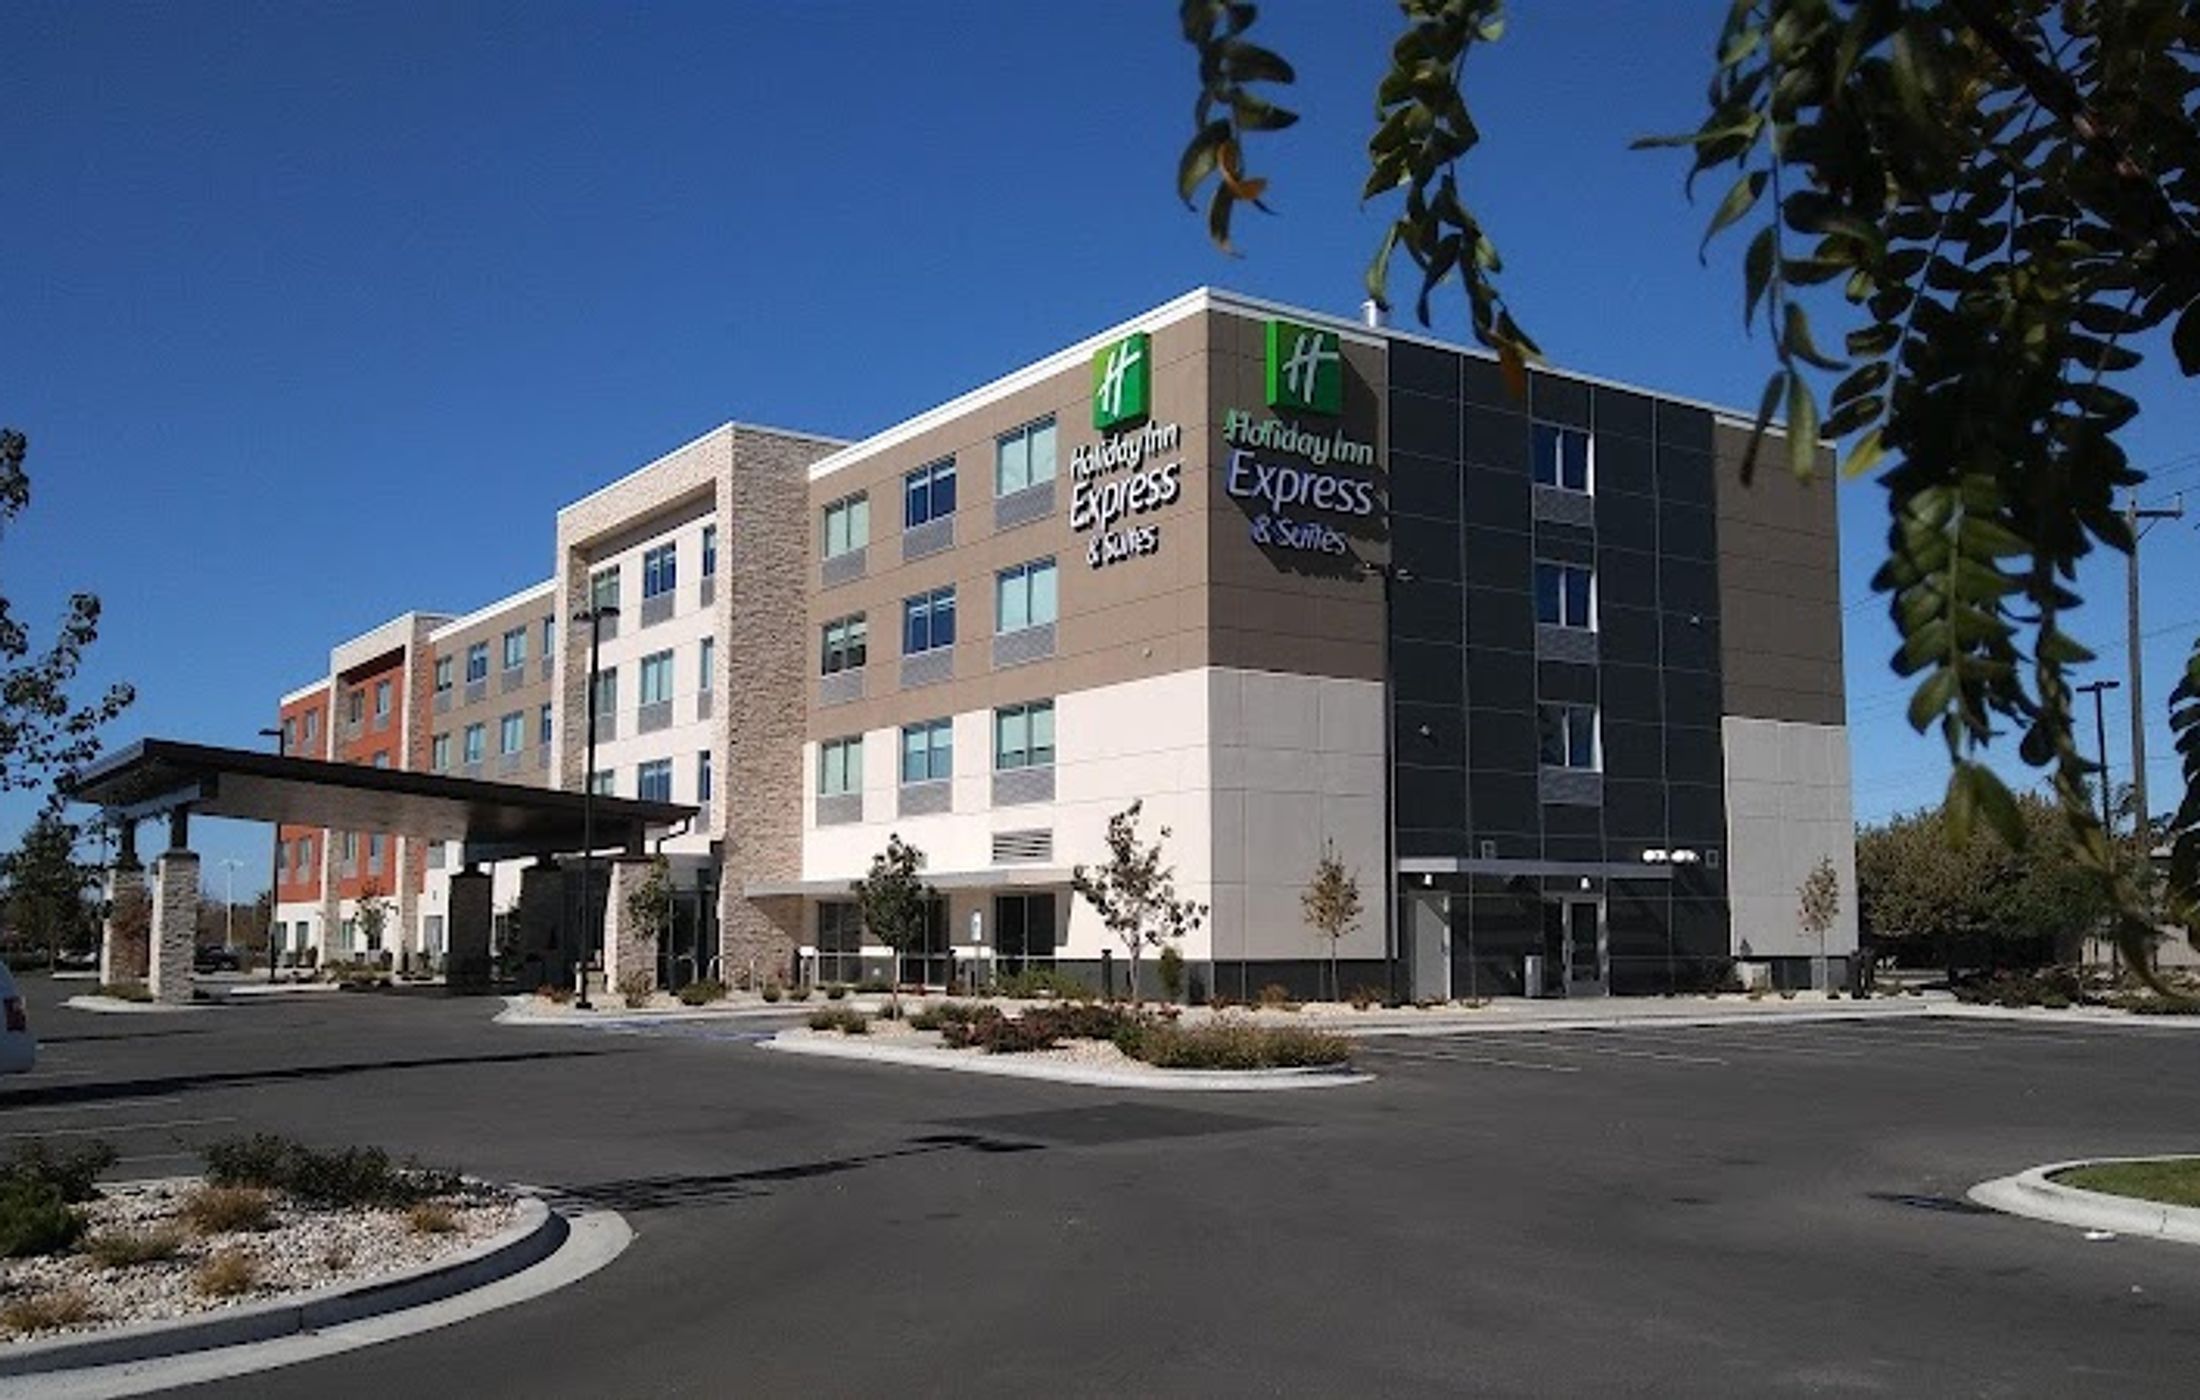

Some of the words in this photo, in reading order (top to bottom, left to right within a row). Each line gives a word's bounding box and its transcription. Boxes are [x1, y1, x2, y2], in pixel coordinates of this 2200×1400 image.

[1070, 432, 1143, 480] Holiday
[1145, 420, 1178, 453] Inn
[1223, 409, 1330, 465] Holiday
[1332, 428, 1374, 465] Inn
[1070, 462, 1178, 530] Express
[1228, 450, 1374, 515] Express
[1086, 535, 1101, 566] &
[1103, 524, 1159, 562] Suites
[1252, 514, 1271, 543] &
[1276, 518, 1347, 555] Suites
